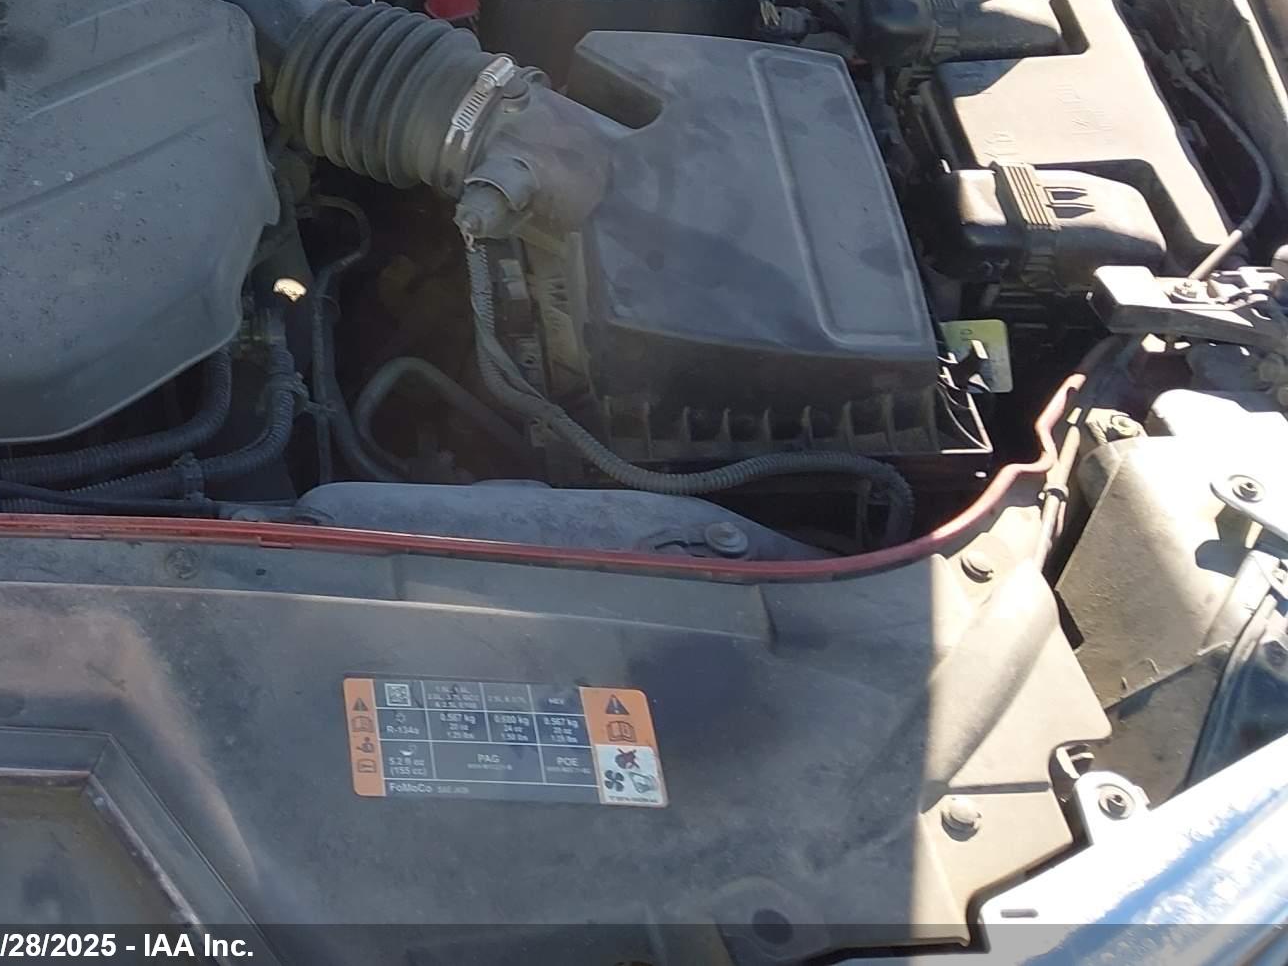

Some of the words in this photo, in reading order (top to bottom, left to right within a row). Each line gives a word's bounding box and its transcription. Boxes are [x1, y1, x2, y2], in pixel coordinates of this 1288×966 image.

[464, 714, 476, 724] kg
[517, 715, 529, 726] kg
[477, 753, 501, 763] PAG
[389, 782, 432, 793] FoMoCo
